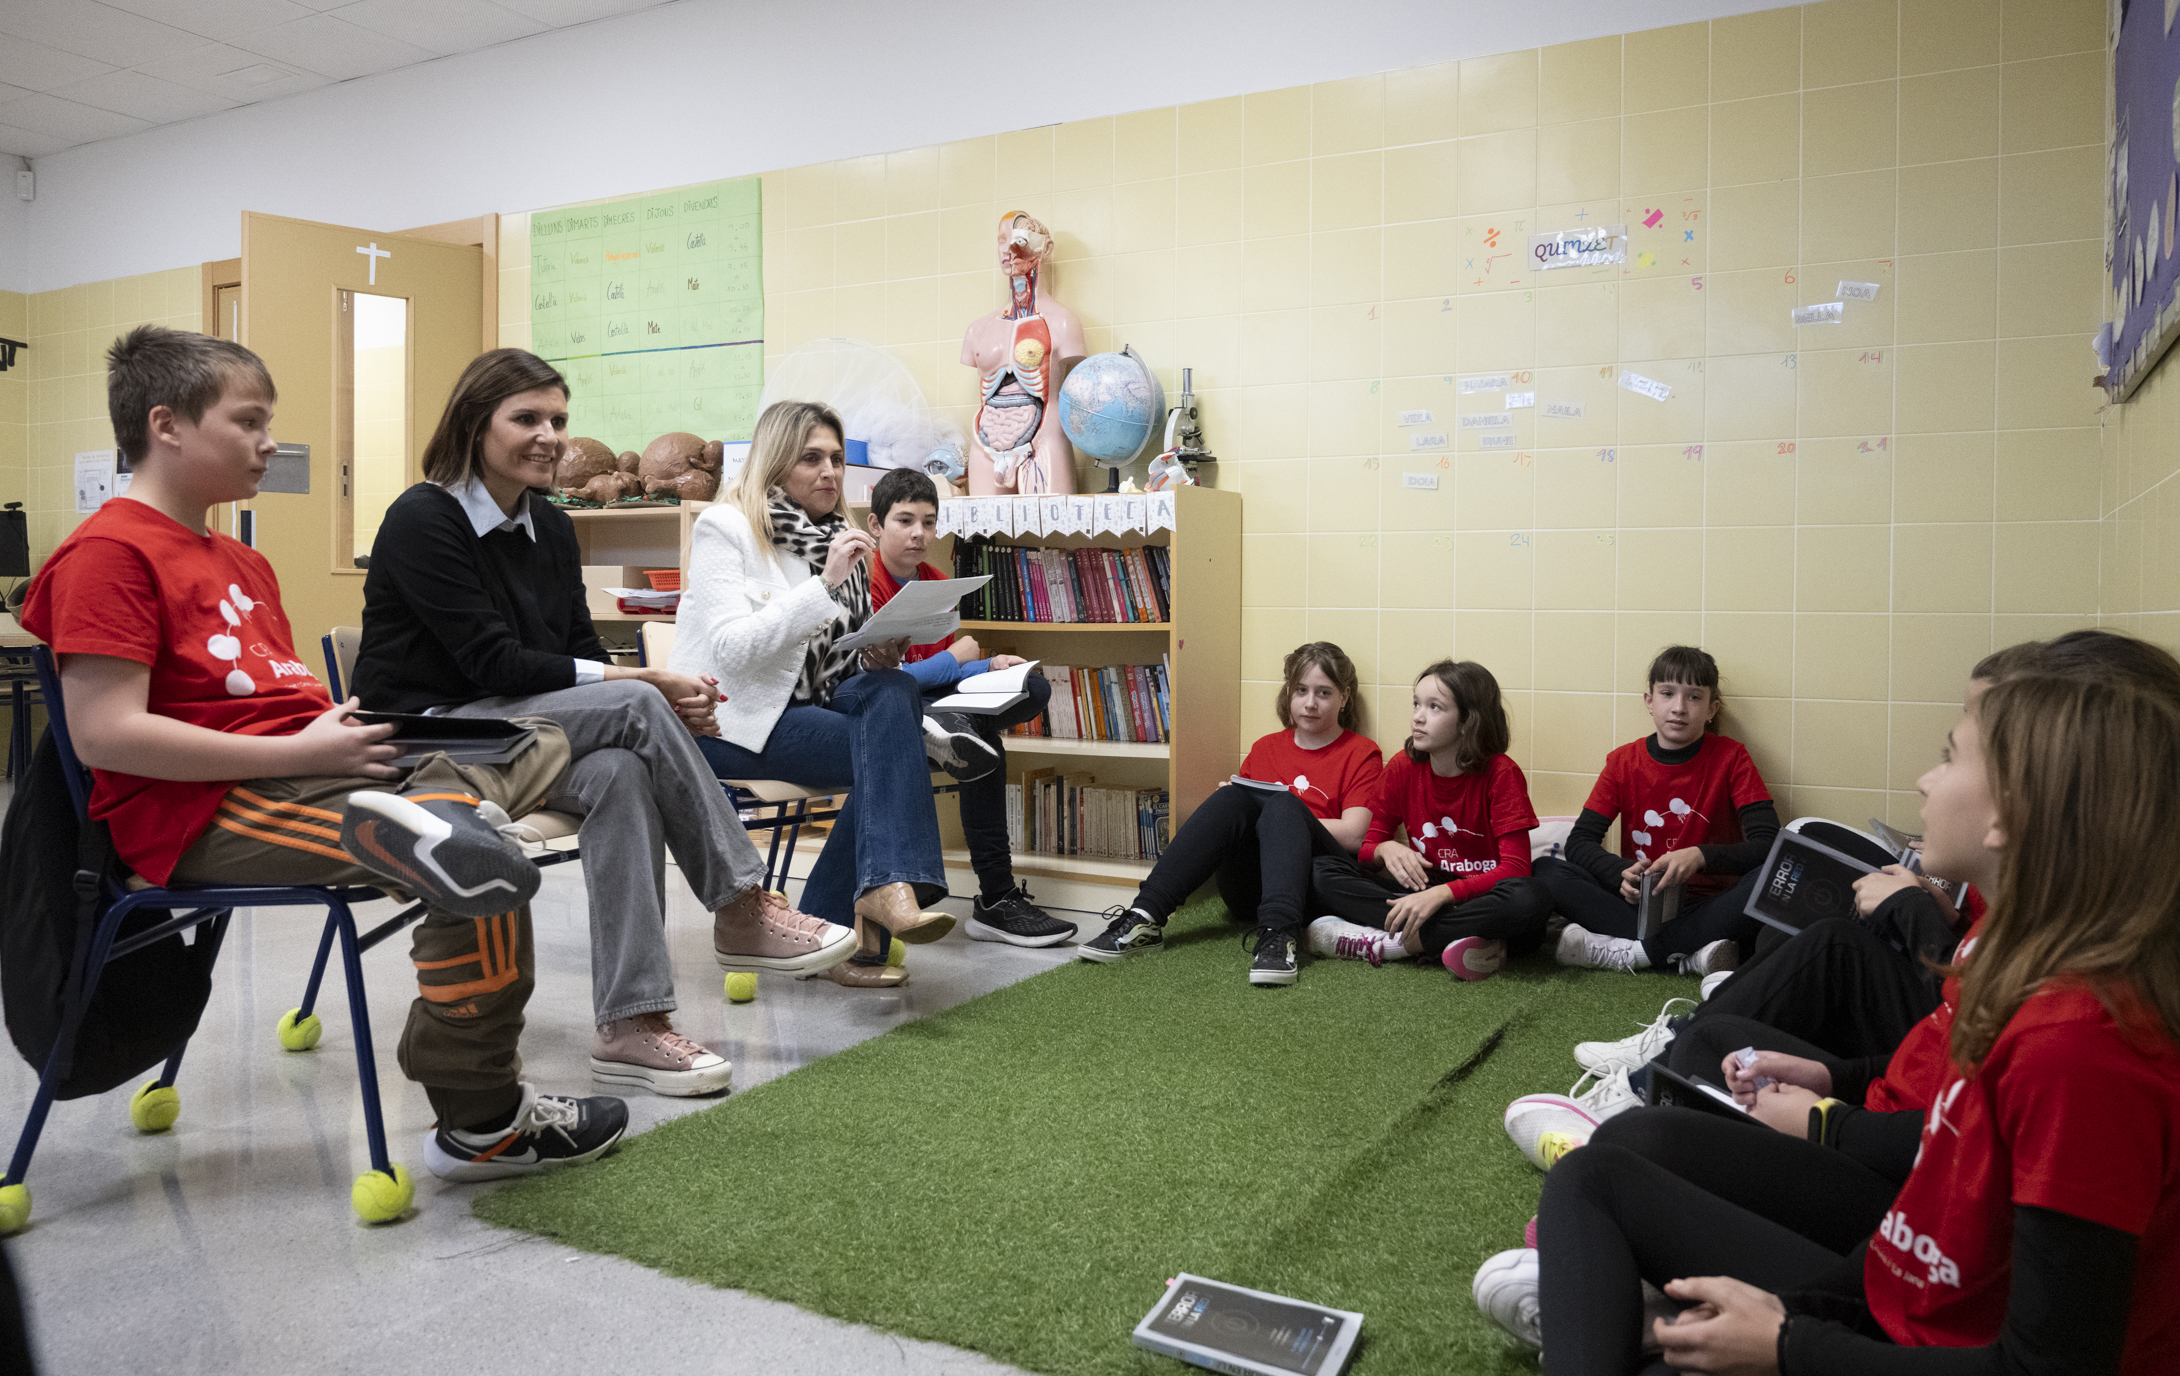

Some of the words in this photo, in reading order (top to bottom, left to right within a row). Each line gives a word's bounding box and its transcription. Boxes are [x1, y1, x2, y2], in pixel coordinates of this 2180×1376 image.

[1784, 267, 1796, 284] 6
[1691, 276, 1703, 291] 5
[1776, 442, 1796, 455] 20
[1437, 848, 1458, 859] CRA
[1440, 858, 1497, 874] Araboga
